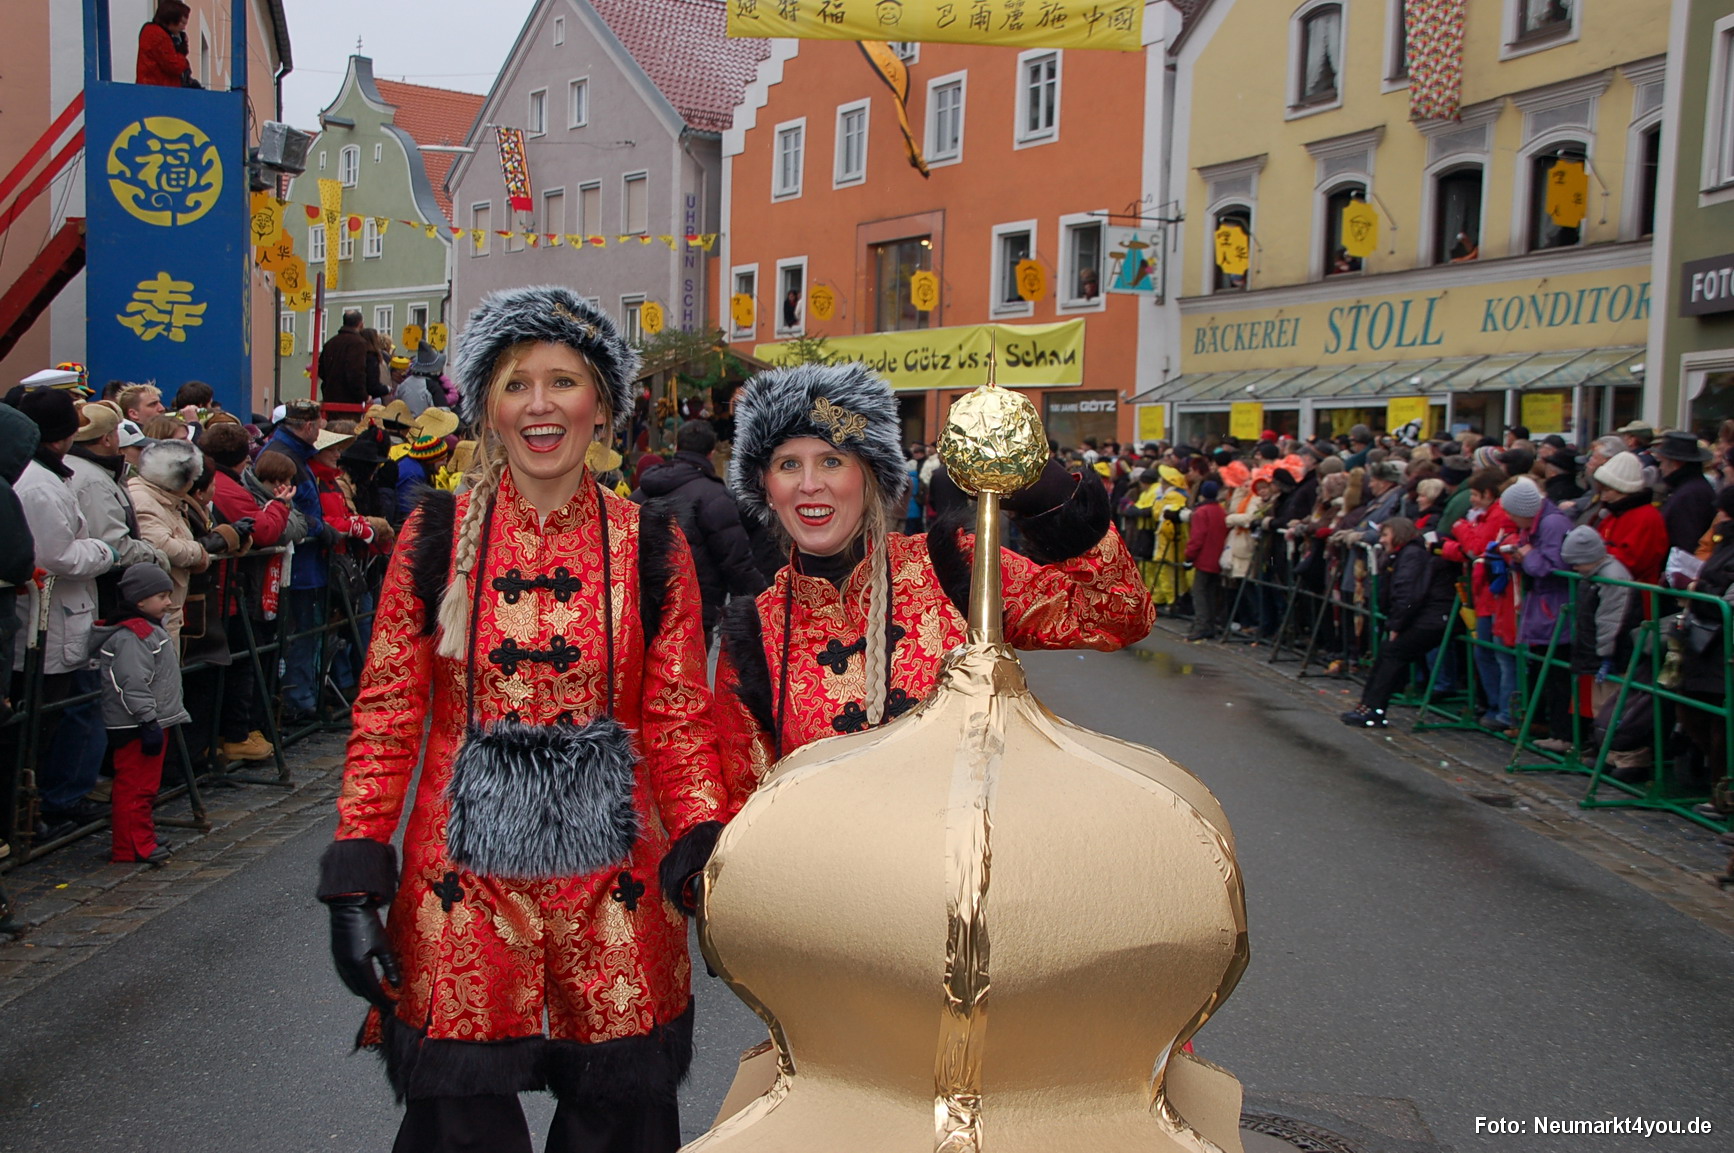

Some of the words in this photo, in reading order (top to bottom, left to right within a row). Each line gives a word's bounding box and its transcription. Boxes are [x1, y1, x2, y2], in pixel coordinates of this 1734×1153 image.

[1193, 316, 1301, 355] BÄCKEREI
[1323, 297, 1445, 355] STOLL
[904, 346, 952, 373] Götz
[1005, 341, 1076, 368] Schau
[1080, 399, 1117, 412] GÖTZ
